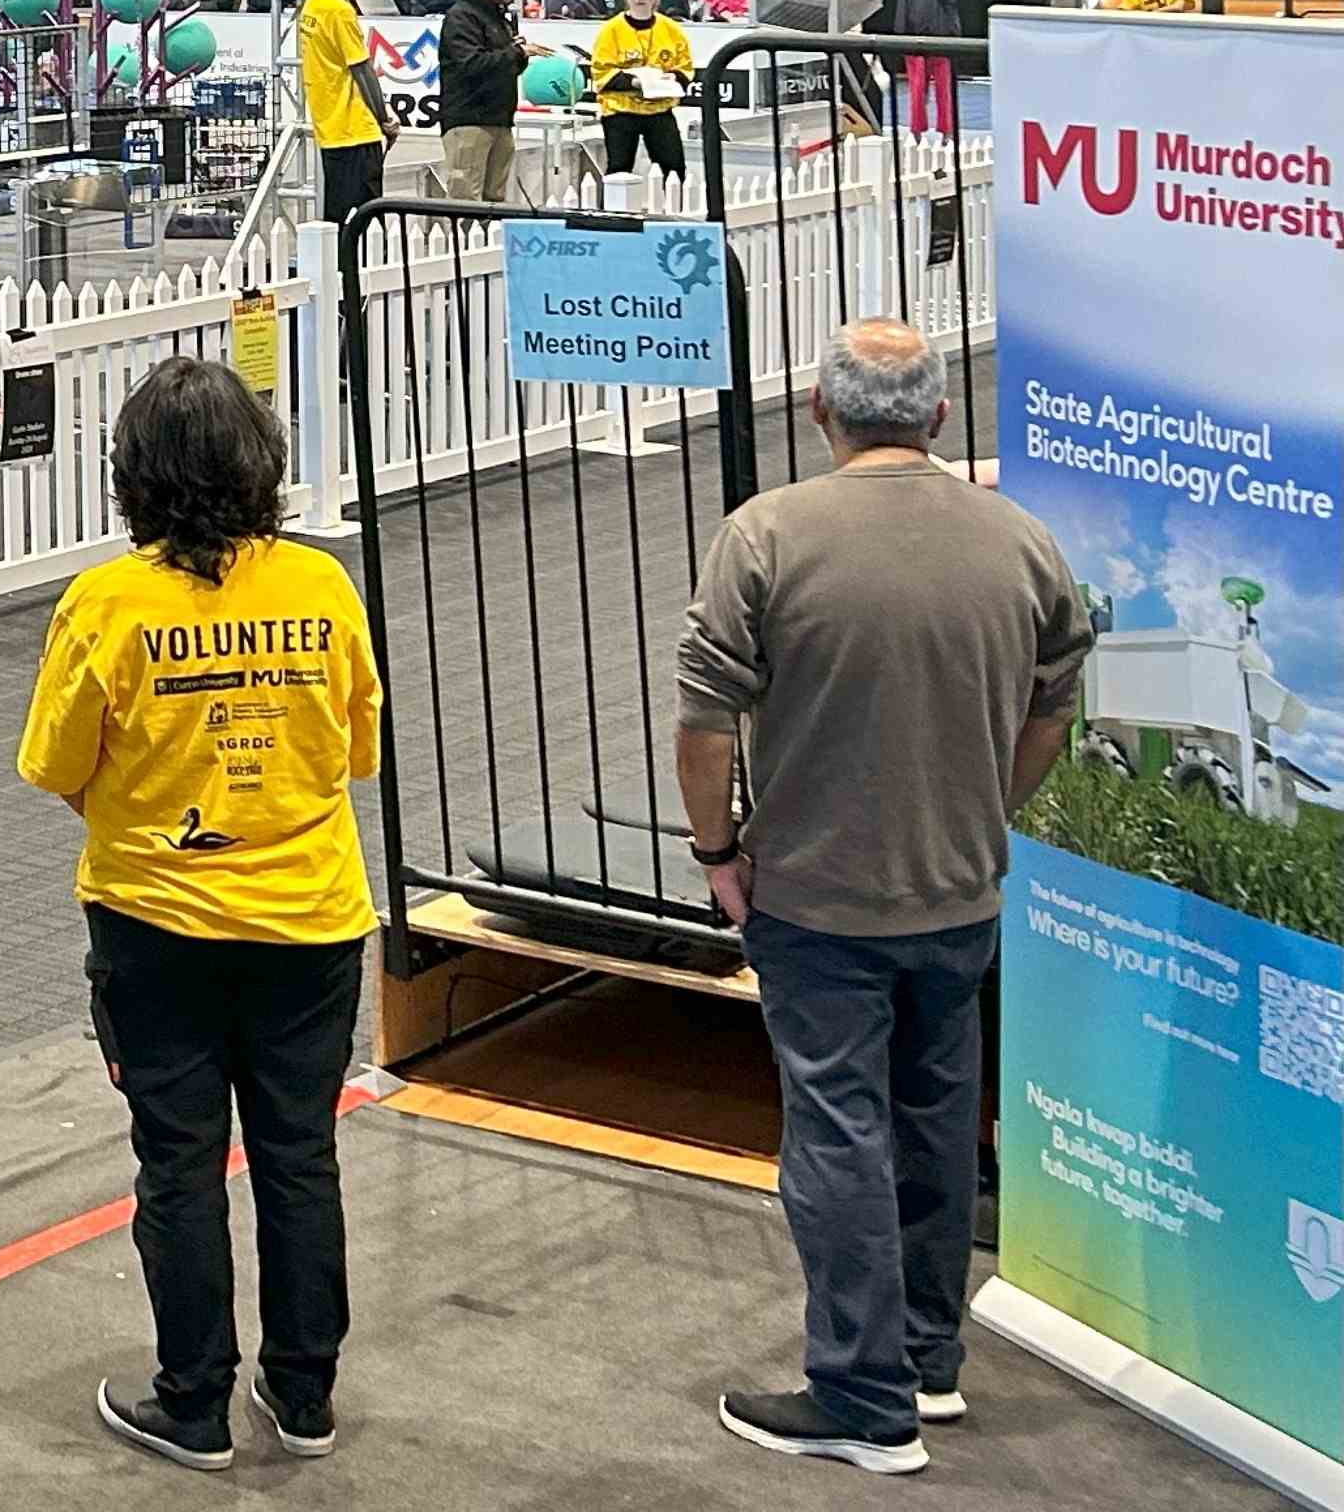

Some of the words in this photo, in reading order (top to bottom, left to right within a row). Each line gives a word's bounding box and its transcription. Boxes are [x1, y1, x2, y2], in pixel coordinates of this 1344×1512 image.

[1021, 120, 1139, 216] MU
[1155, 131, 1331, 186] Murdoch
[1155, 181, 1344, 250] University
[546, 241, 600, 257] FIRST
[544, 292, 602, 317] Lost
[611, 294, 682, 320] Child
[524, 330, 626, 364] Meeting
[637, 335, 711, 361] Point
[1024, 379, 1092, 426] State
[1096, 394, 1272, 462] Agricultural
[1025, 422, 1222, 506] Biotechnology
[1226, 464, 1335, 520] Centre
[143, 617, 334, 663] VOLUNTEER
[251, 669, 282, 688] MU
[226, 736, 275, 750] GRDC
[1026, 903, 1092, 953] Where
[1093, 930, 1111, 961] is
[1111, 942, 1162, 978] your
[1166, 955, 1240, 1005] future?
[1025, 1080, 1083, 1127] Ngala
[1051, 1125, 1126, 1187] Building
[1128, 1168, 1144, 1187] a
[1146, 1169, 1225, 1224] brighter
